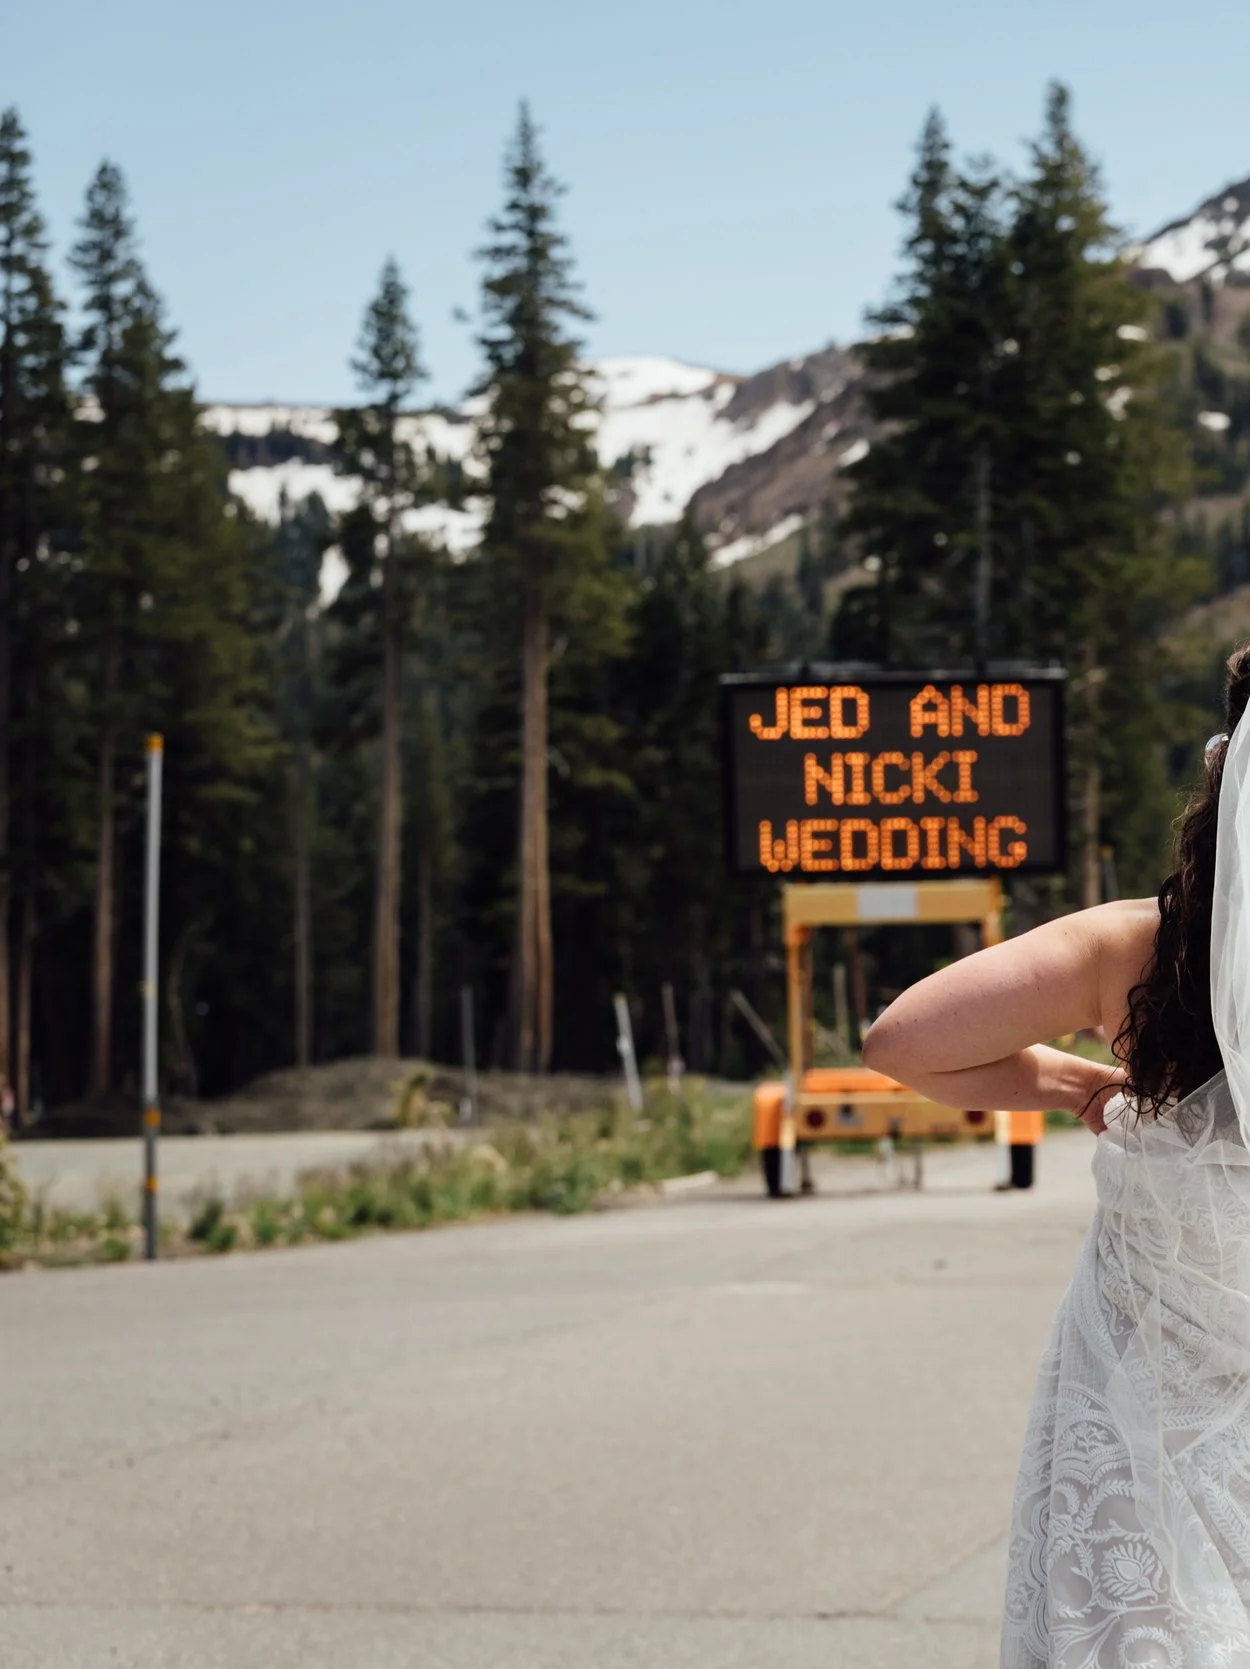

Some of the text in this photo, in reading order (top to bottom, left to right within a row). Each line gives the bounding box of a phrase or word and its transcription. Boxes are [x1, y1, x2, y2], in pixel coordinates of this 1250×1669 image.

[749, 684, 1030, 739] JED AND
[804, 750, 978, 805] NICKI
[759, 816, 1027, 872] WEDDING
